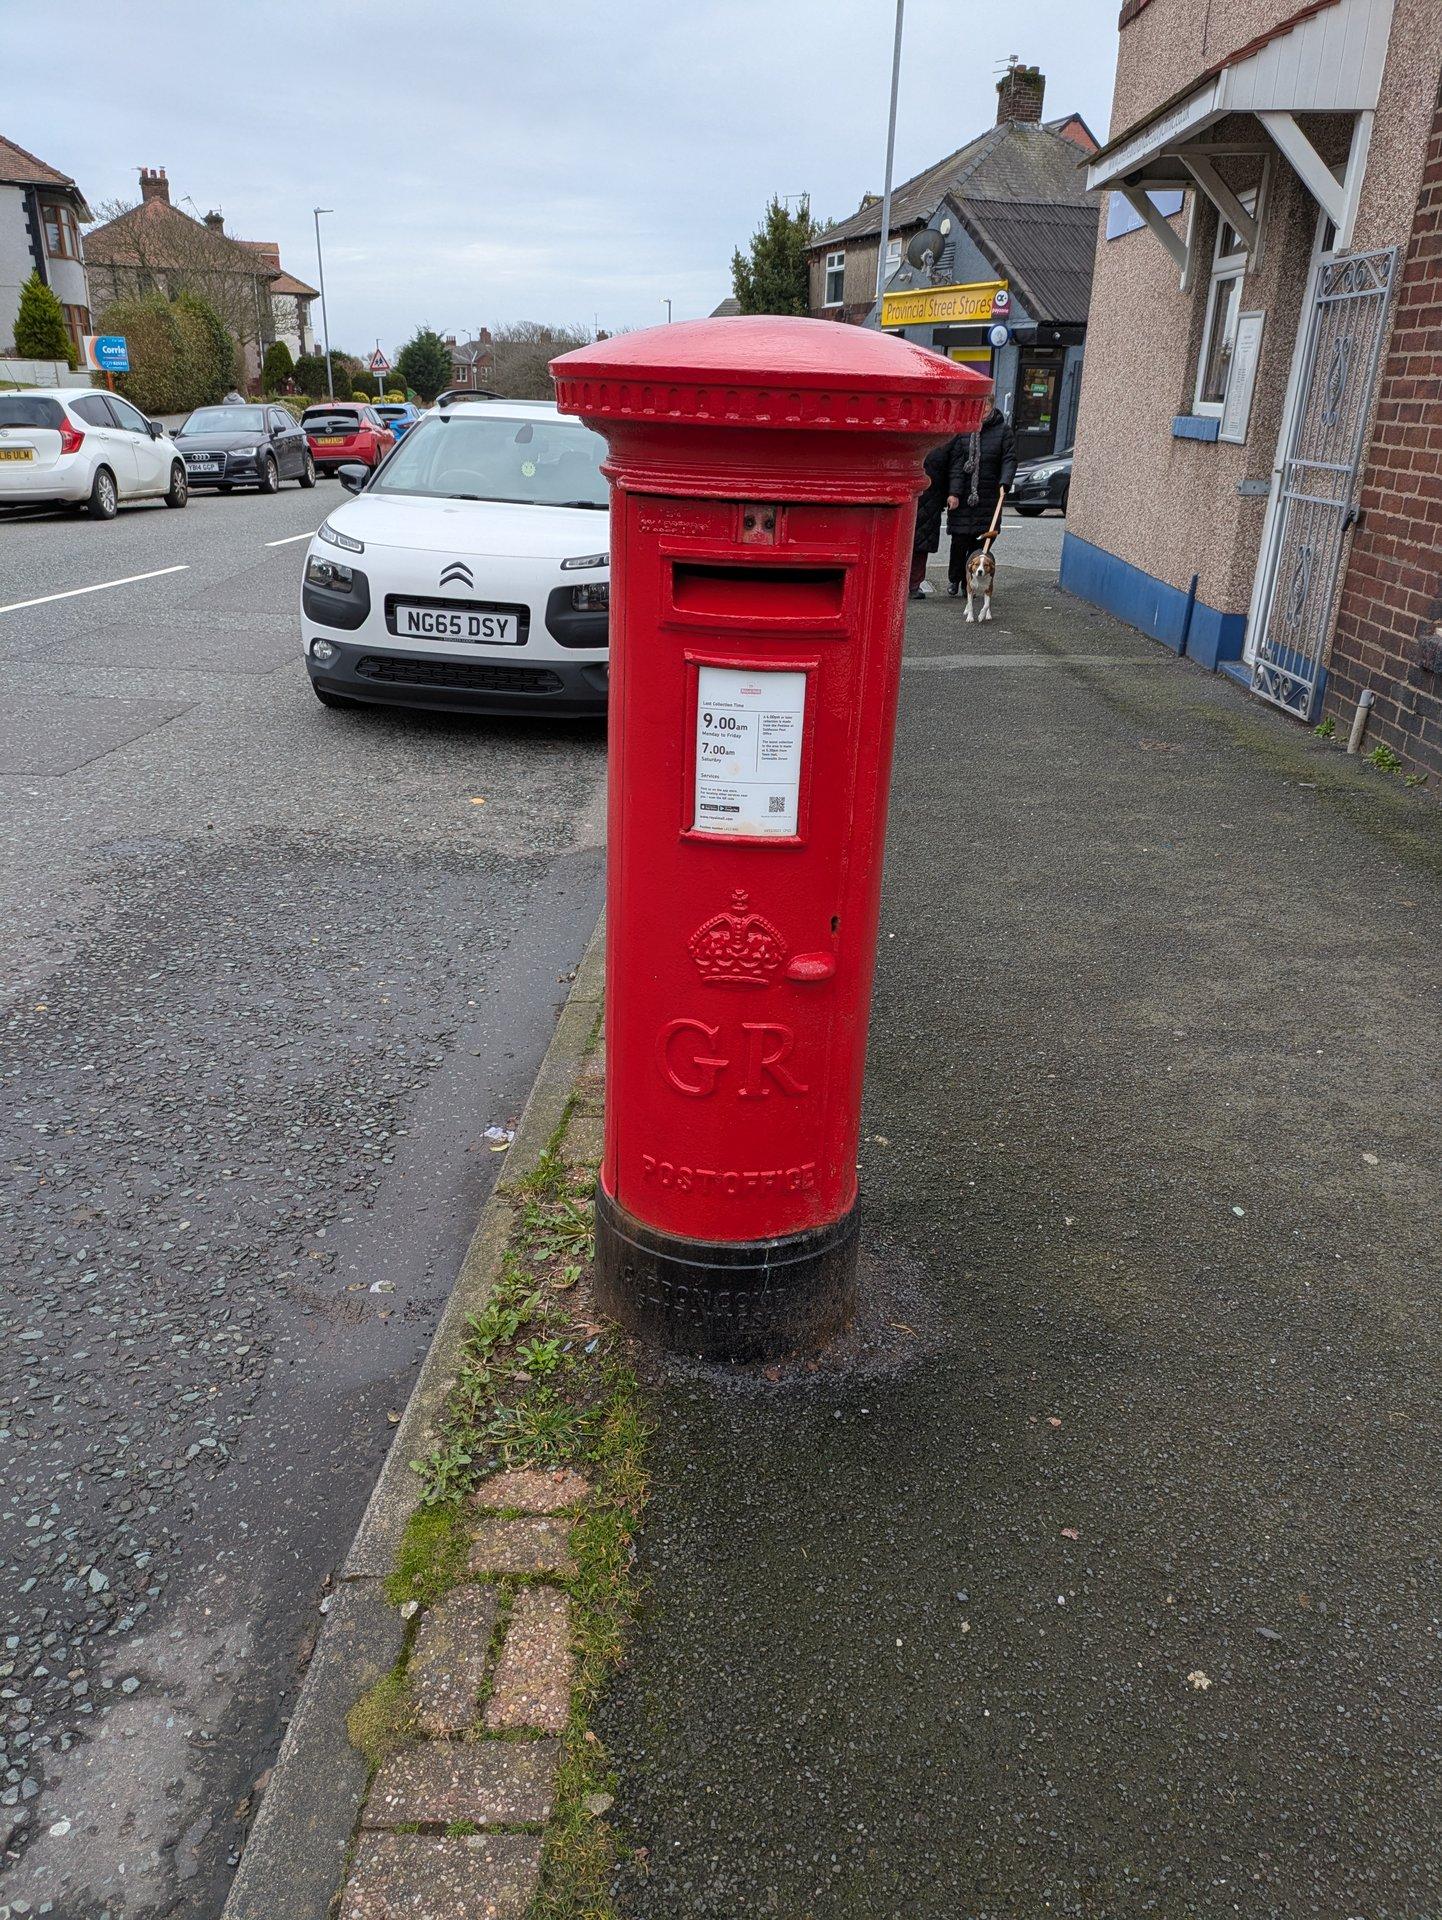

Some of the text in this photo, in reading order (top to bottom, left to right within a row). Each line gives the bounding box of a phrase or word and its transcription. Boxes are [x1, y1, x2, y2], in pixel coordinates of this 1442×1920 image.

[886, 296, 992, 320] Provincial Street Stores
[102, 346, 126, 354] Corrie
[408, 612, 508, 638] NG65 DSY
[703, 712, 748, 731] 9.00am
[702, 742, 736, 756] 7.00am
[655, 1018, 809, 1098] GR
[642, 1153, 817, 1195] POST OFFICE
